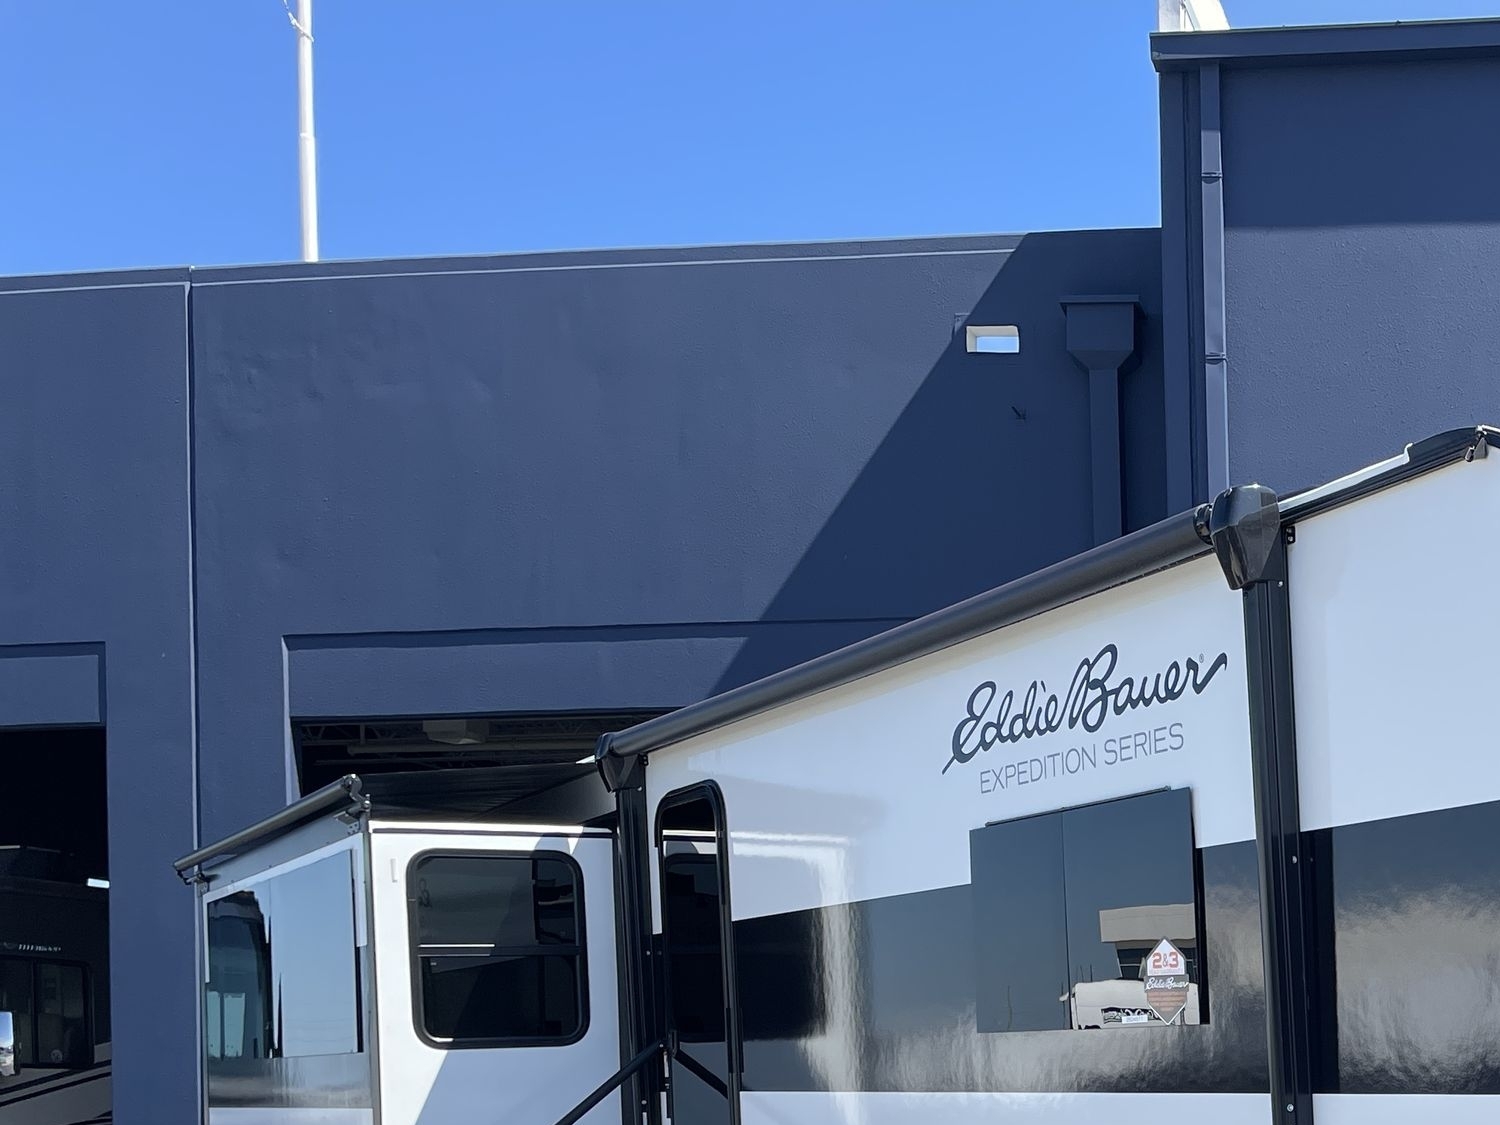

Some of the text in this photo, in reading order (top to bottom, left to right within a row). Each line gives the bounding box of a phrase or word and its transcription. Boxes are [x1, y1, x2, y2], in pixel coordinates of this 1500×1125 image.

[942, 680, 1064, 775] Eddie
[979, 722, 1185, 795] EXPEDITION SERIES
[1152, 951, 1179, 969] 2&3
